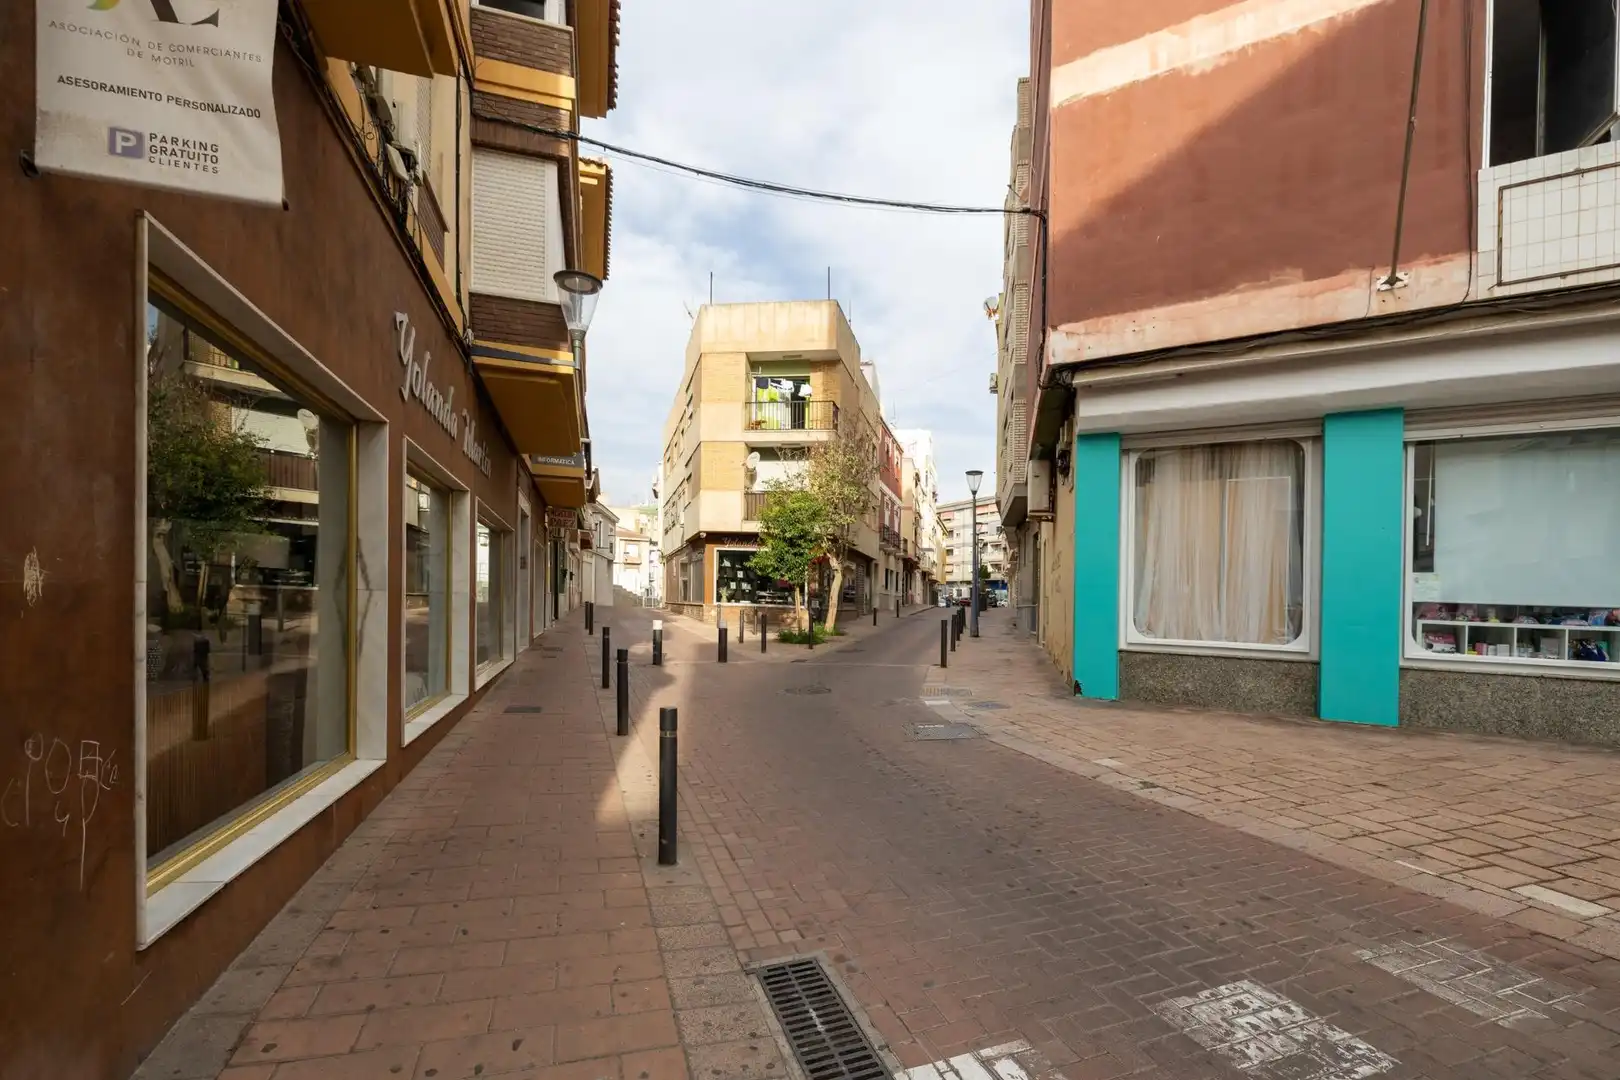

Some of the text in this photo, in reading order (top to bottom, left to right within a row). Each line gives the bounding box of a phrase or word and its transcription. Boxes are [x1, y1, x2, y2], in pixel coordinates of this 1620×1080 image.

[126, 47, 195, 68] DE MOTRIL
[147, 41, 164, 51] DE
[168, 43, 262, 63] COMERCIANTES
[56, 74, 261, 119] ASESORAMIENTO PERSONALIZADO
[148, 132, 219, 153] PARKING
[148, 144, 219, 164] GRATUITO
[148, 156, 219, 174] CLIENTES
[395, 311, 458, 440] Yolanda
